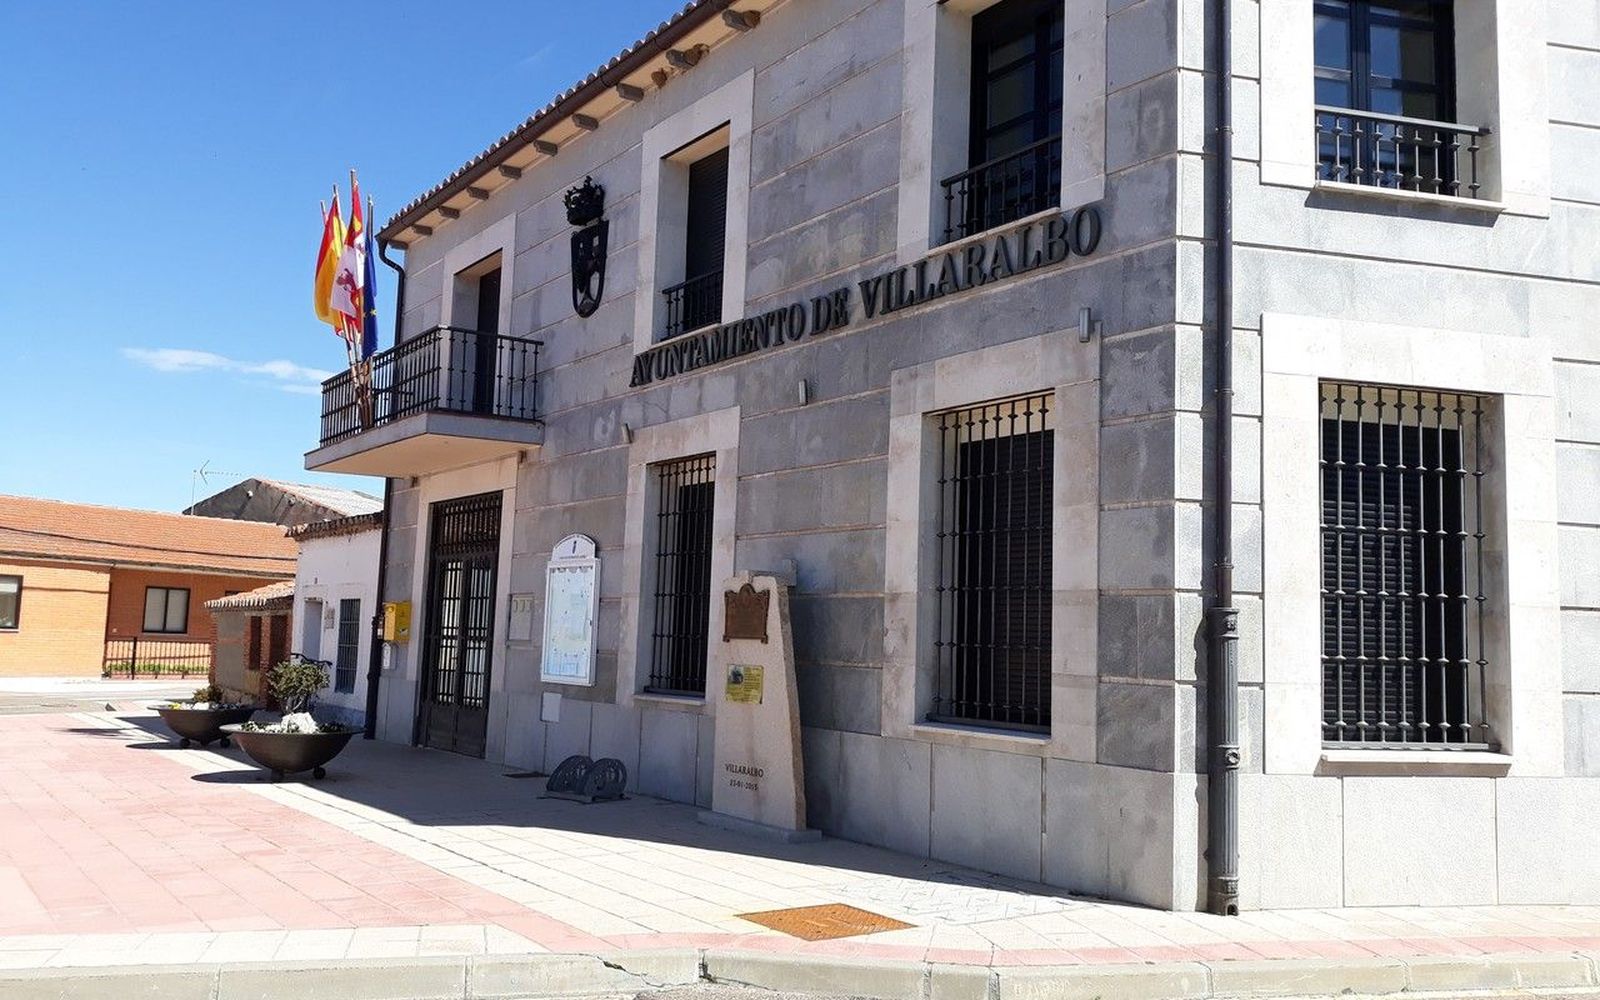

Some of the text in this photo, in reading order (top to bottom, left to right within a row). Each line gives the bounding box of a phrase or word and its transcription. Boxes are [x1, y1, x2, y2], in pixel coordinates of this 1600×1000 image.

[629, 206, 1102, 388] AYUNTAMIENTO DE VILLARALBO
[724, 763, 764, 778] VILLARALBO
